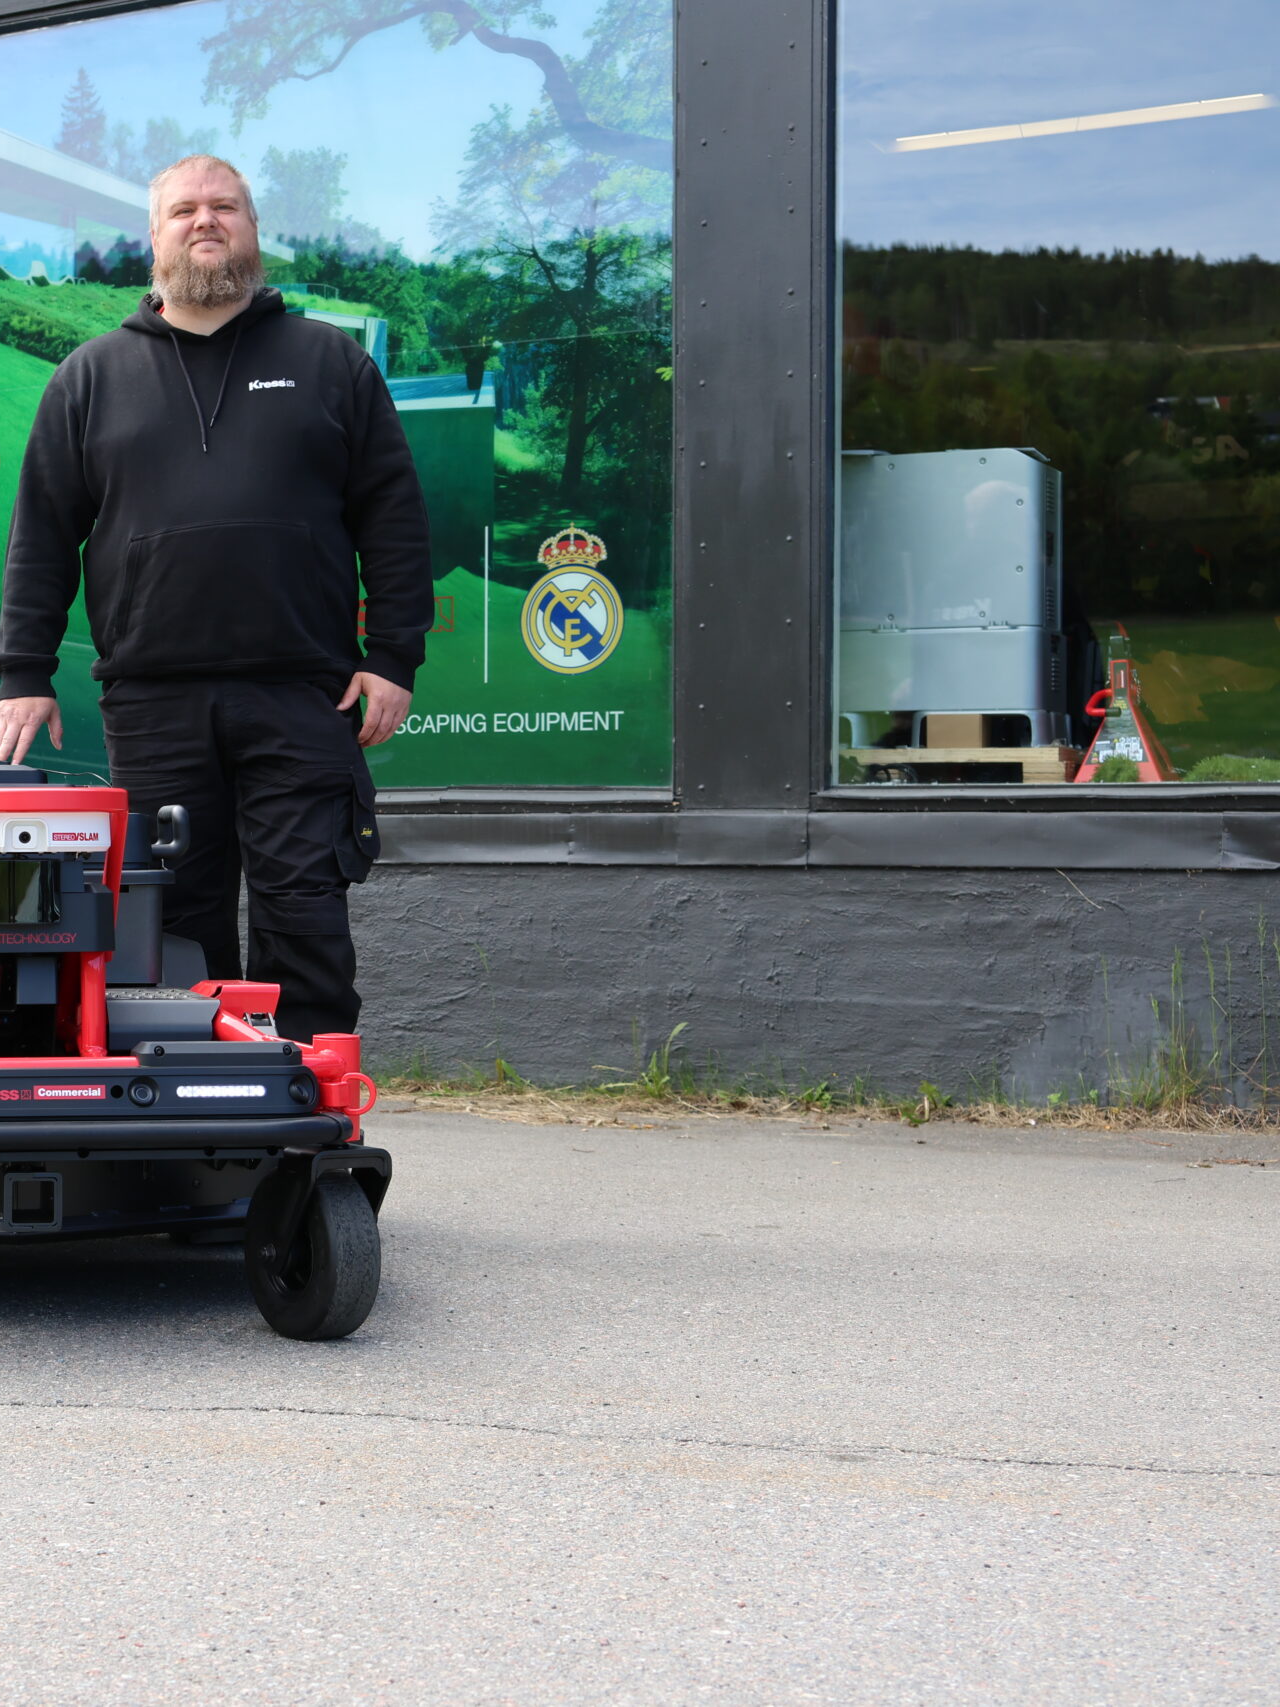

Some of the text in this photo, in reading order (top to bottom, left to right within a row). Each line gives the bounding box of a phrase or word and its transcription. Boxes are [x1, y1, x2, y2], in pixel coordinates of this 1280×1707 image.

[248, 379, 286, 391] Kress
[493, 710, 625, 733] EQUIPMENT
[37, 1087, 101, 1097] Commercial
